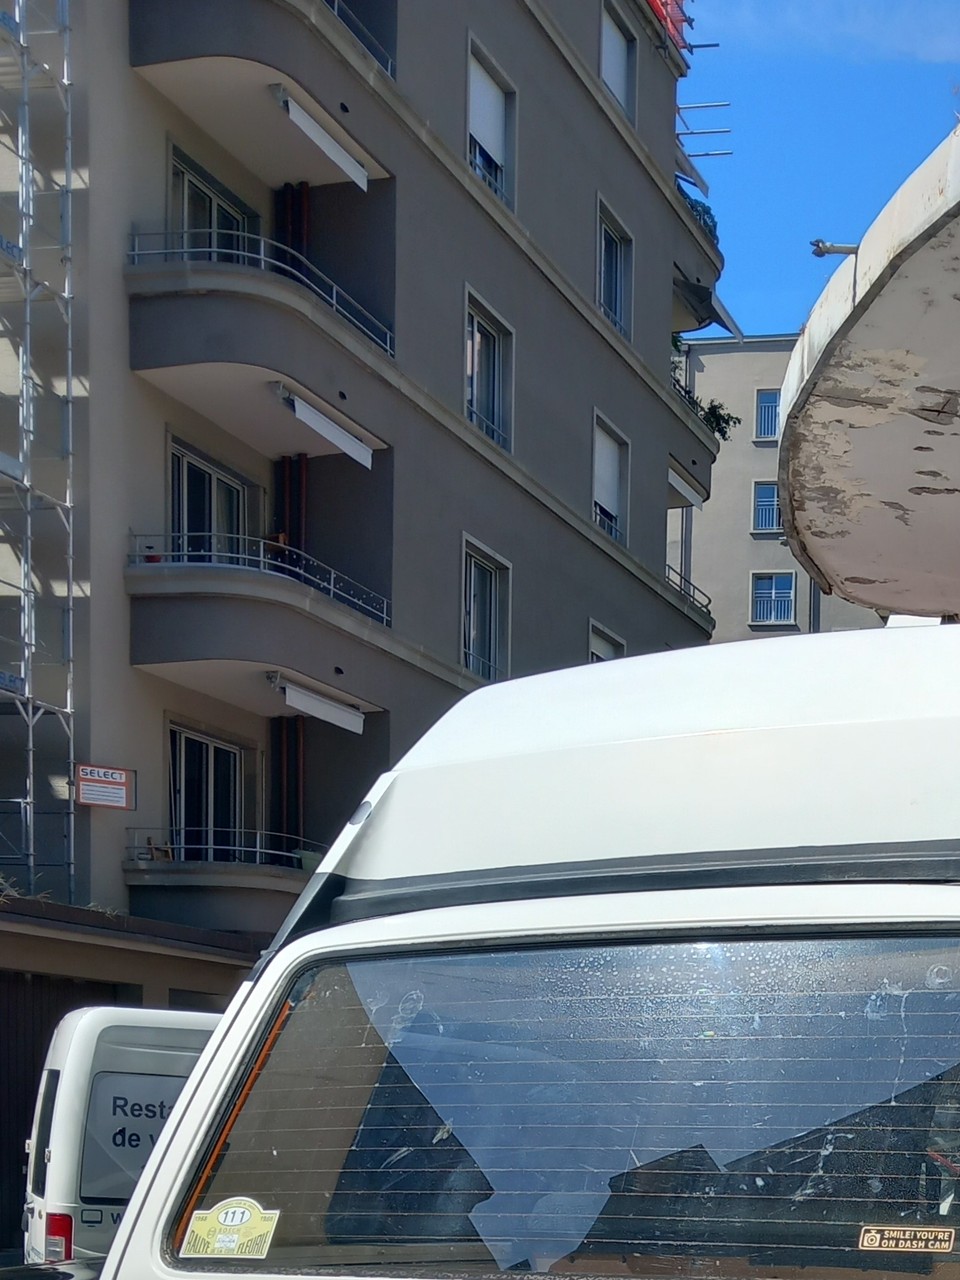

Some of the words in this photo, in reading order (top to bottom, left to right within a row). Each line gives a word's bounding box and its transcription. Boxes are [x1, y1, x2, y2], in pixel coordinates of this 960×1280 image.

[81, 768, 124, 780] SELECT
[112, 1127, 141, 1148] de
[223, 1210, 246, 1223] 111
[884, 1230, 914, 1239] SMILE!
[916, 1231, 950, 1240] YOU'RE
[898, 1240, 925, 1248] DASH
[928, 1241, 949, 1249] CAM
